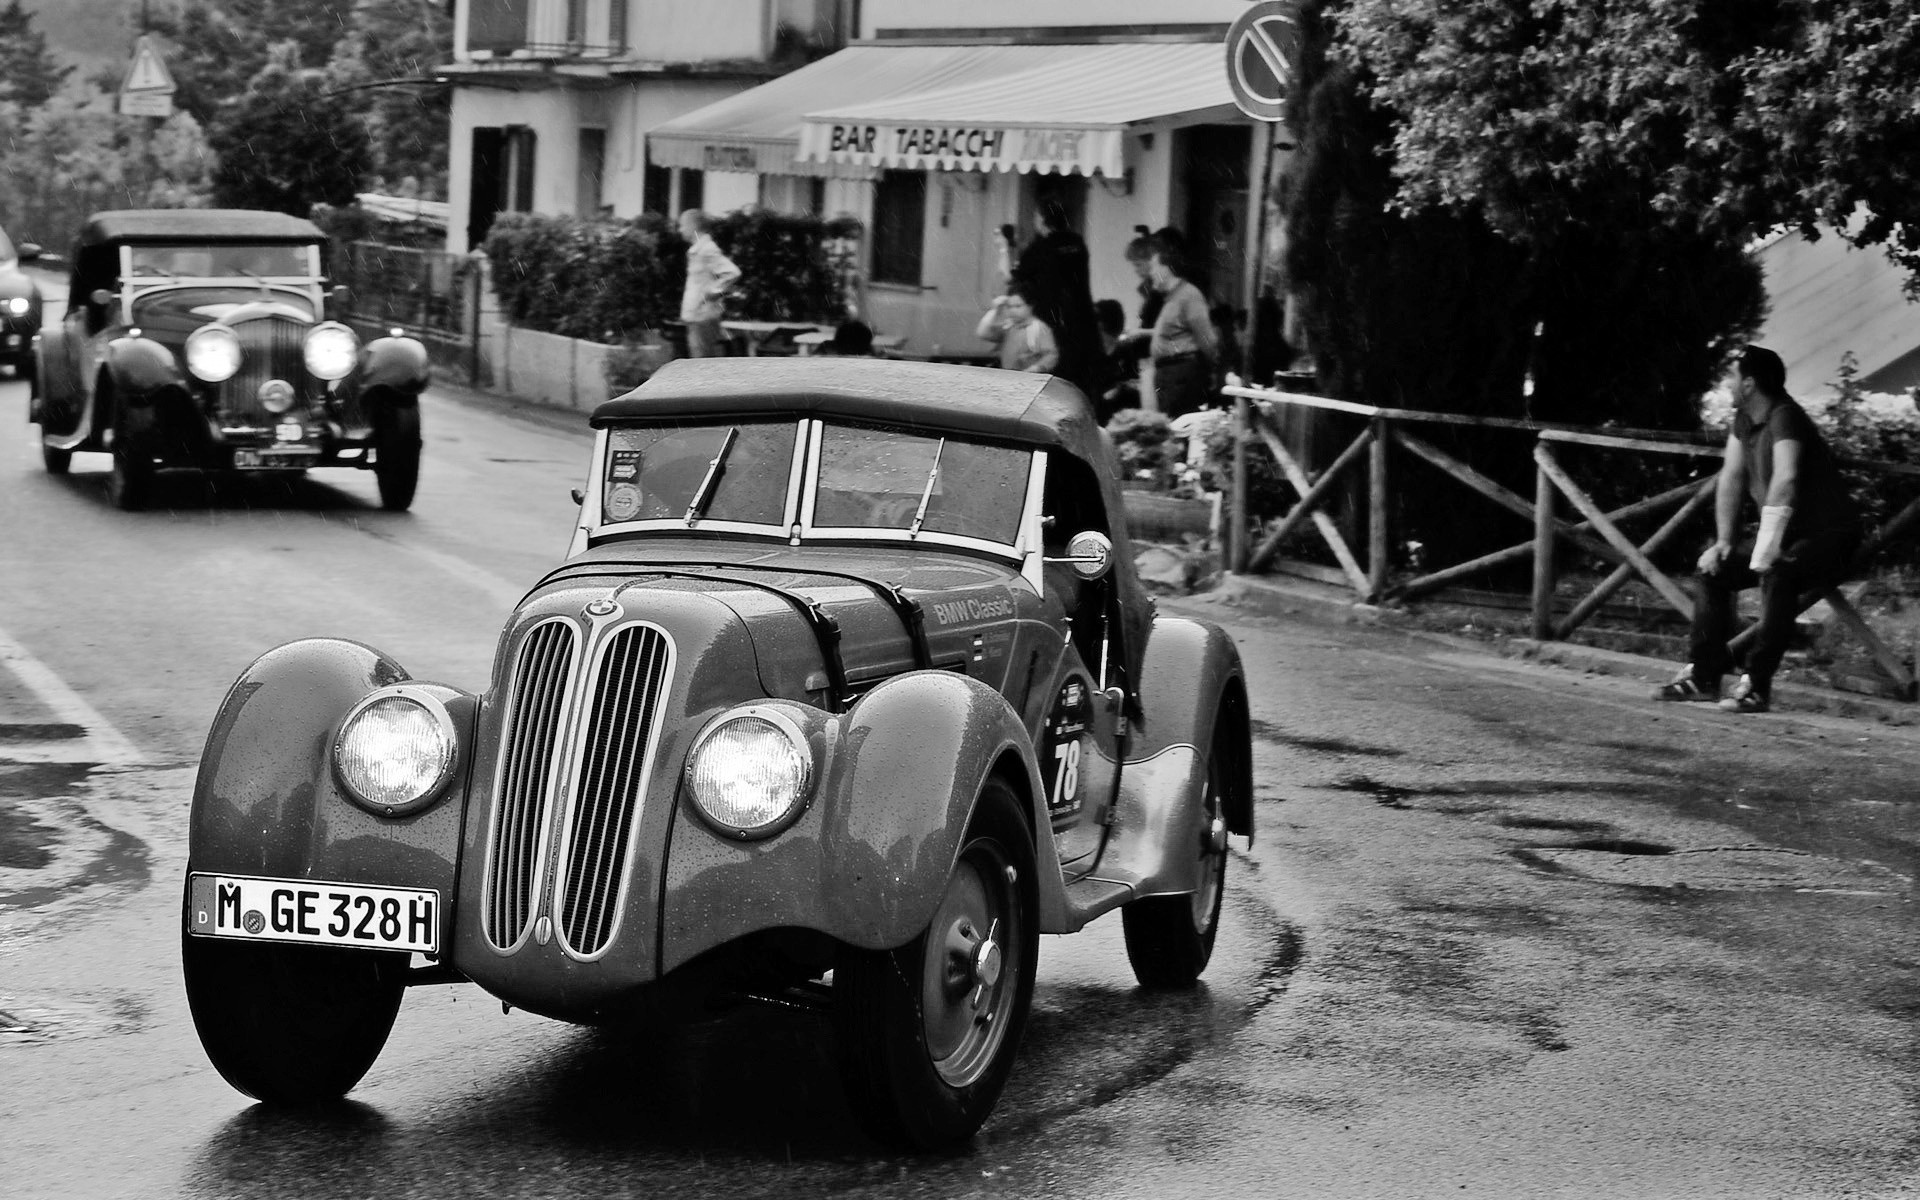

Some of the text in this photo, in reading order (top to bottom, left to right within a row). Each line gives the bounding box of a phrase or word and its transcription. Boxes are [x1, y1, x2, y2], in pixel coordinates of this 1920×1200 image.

[831, 125, 876, 153] BAR
[896, 128, 1004, 158] TABACCHI
[933, 595, 1013, 625] BMW Classic
[1052, 739, 1081, 804] 78
[197, 910, 208, 925] D
[217, 884, 242, 929] M
